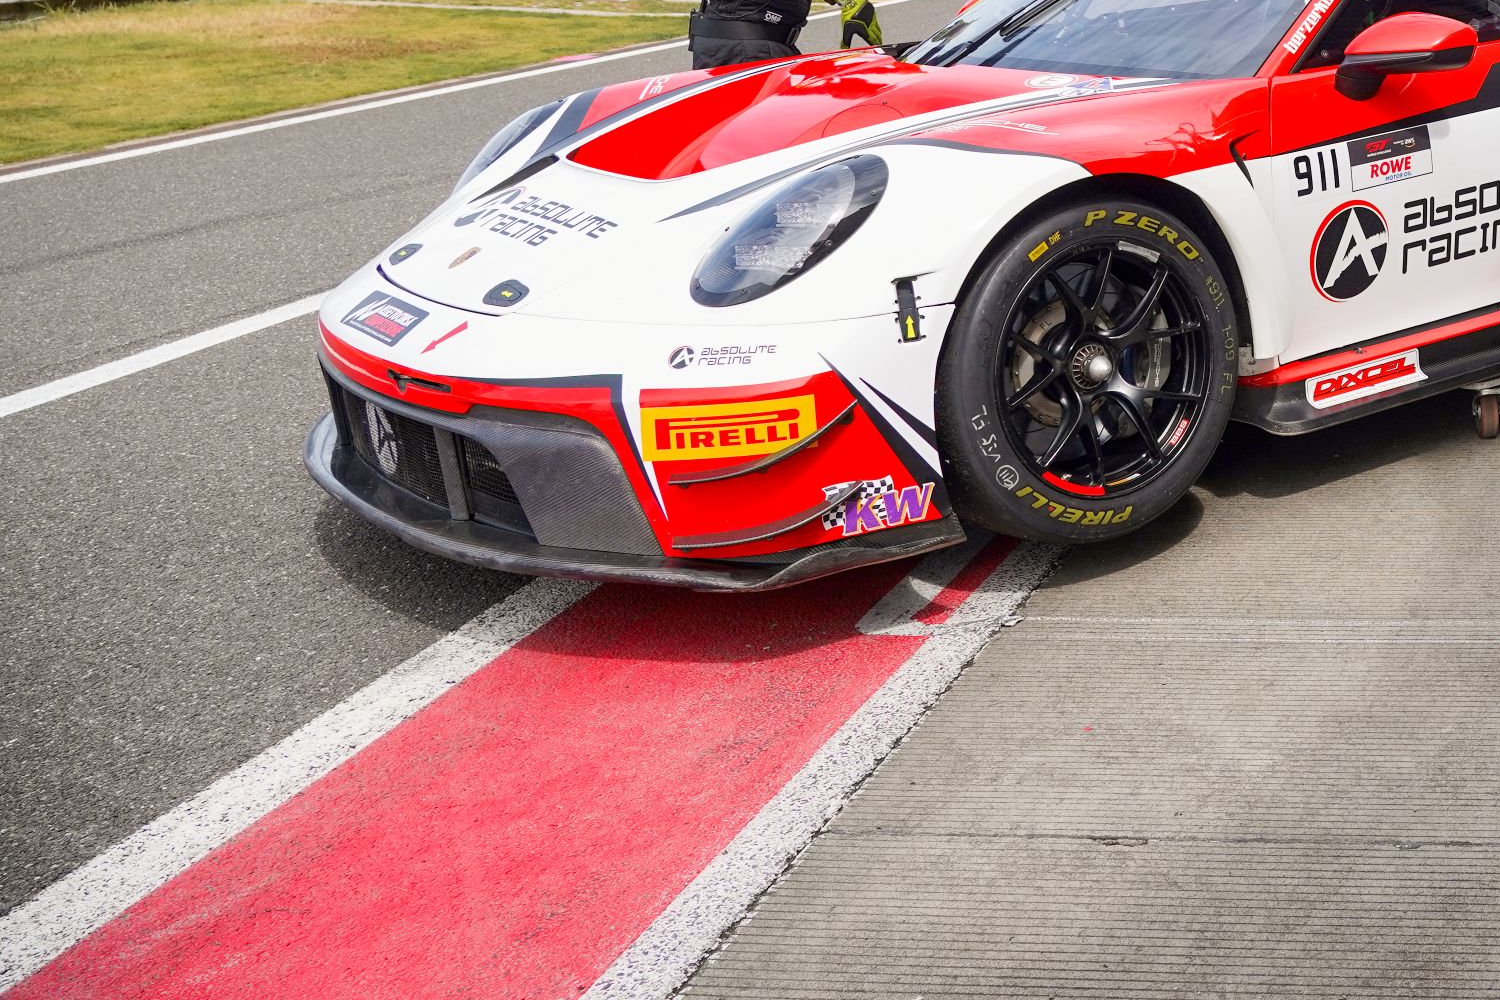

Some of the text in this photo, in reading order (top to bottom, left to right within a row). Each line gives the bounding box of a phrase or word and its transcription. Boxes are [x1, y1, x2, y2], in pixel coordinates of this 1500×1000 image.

[764, 10, 783, 23] OMP
[1293, 148, 1340, 197] 911
[1370, 156, 1411, 178] ROWE
[1385, 172, 1403, 181] MOTOR
[1049, 231, 1061, 245] DHF
[1084, 209, 1201, 261] P ZERO
[1314, 357, 1416, 398] DIXCEL
[655, 408, 800, 450] PIRELLI
[841, 482, 936, 537] KW
[1015, 486, 1133, 526] PIRELLI
